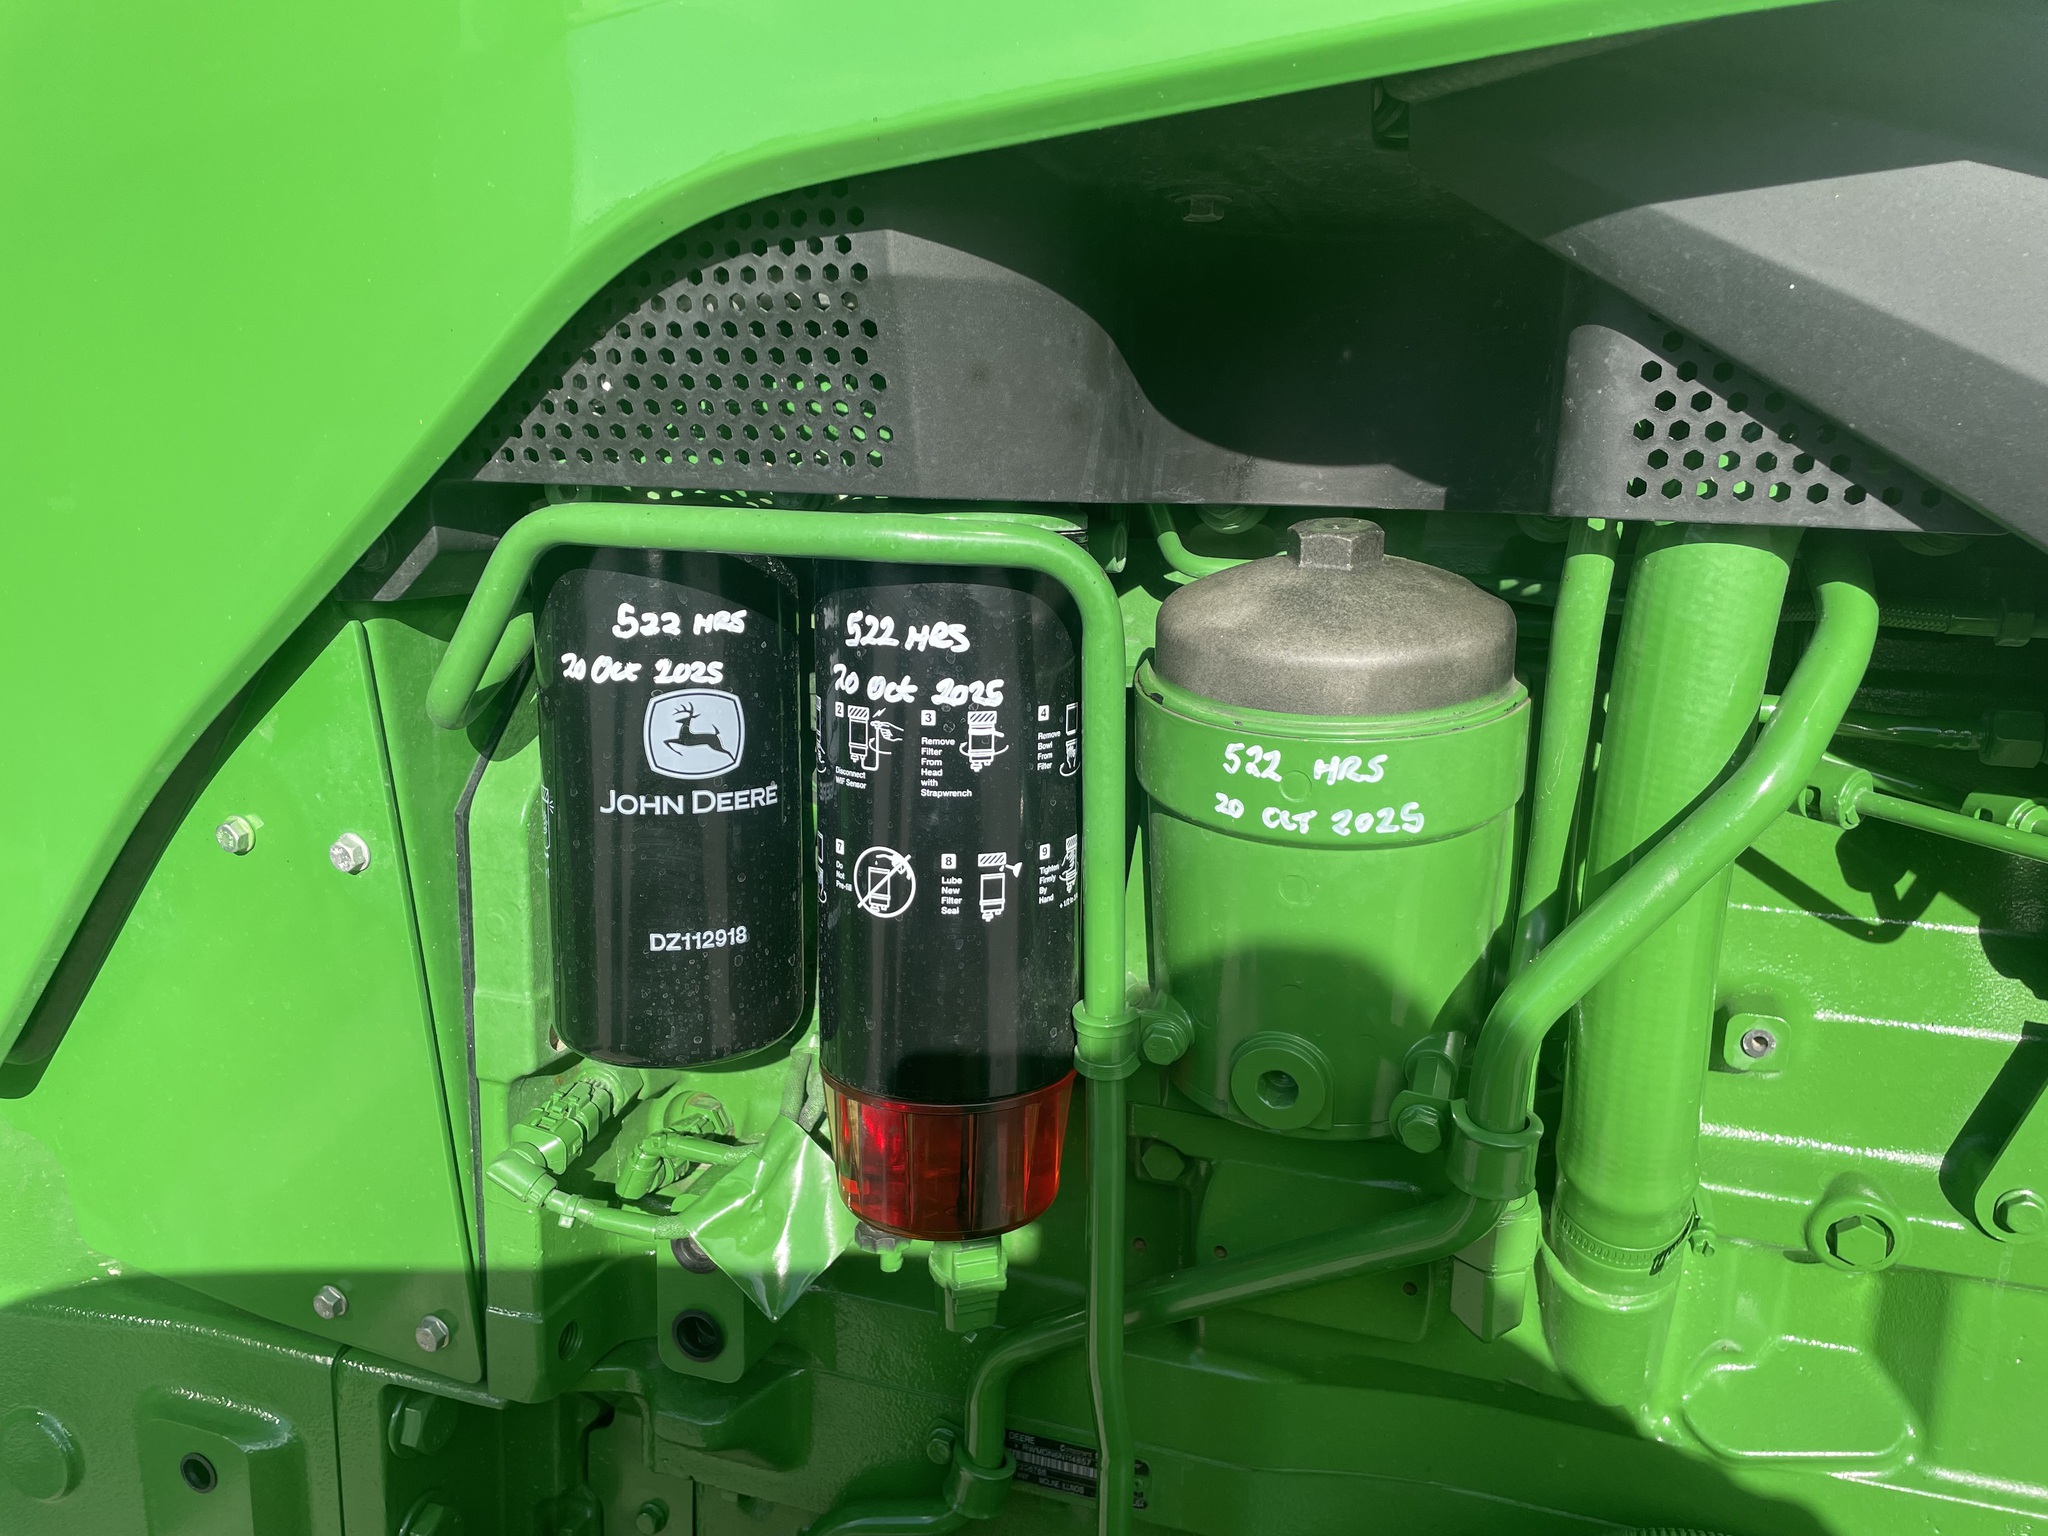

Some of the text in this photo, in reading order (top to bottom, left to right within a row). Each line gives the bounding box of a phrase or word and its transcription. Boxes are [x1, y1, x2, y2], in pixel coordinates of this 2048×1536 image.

[612, 602, 747, 639] 522 HRS
[845, 610, 970, 653] 522 HRS
[561, 653, 586, 681] 20
[653, 658, 724, 685] 2025
[833, 663, 1004, 707] 20 Oct 2025
[1037, 730, 1061, 741] Remove
[921, 737, 955, 746] Remove
[1037, 741, 1053, 751] Bowl
[921, 747, 942, 756] Filter
[1037, 751, 1053, 761] From
[921, 757, 942, 766] From
[1037, 762, 1053, 771] Filter
[1222, 742, 1388, 786] 522 HRS
[835, 765, 866, 779] Disconnect
[921, 767, 943, 777] Head
[845, 778, 867, 790] Sensor
[920, 778, 938, 787] with
[920, 788, 973, 798] Strapwrench
[1214, 792, 1244, 819] 20
[1331, 802, 1425, 836] 2025
[835, 860, 844, 870] Do
[1039, 863, 1059, 875] Tighten
[941, 876, 963, 885] Lube
[1039, 873, 1056, 885] Firmly
[941, 887, 960, 895] New
[1039, 886, 1047, 896] By
[941, 896, 962, 905] Filter
[1038, 894, 1054, 905] Hand
[941, 906, 960, 915] Seal
[649, 926, 747, 951] DZ112918
